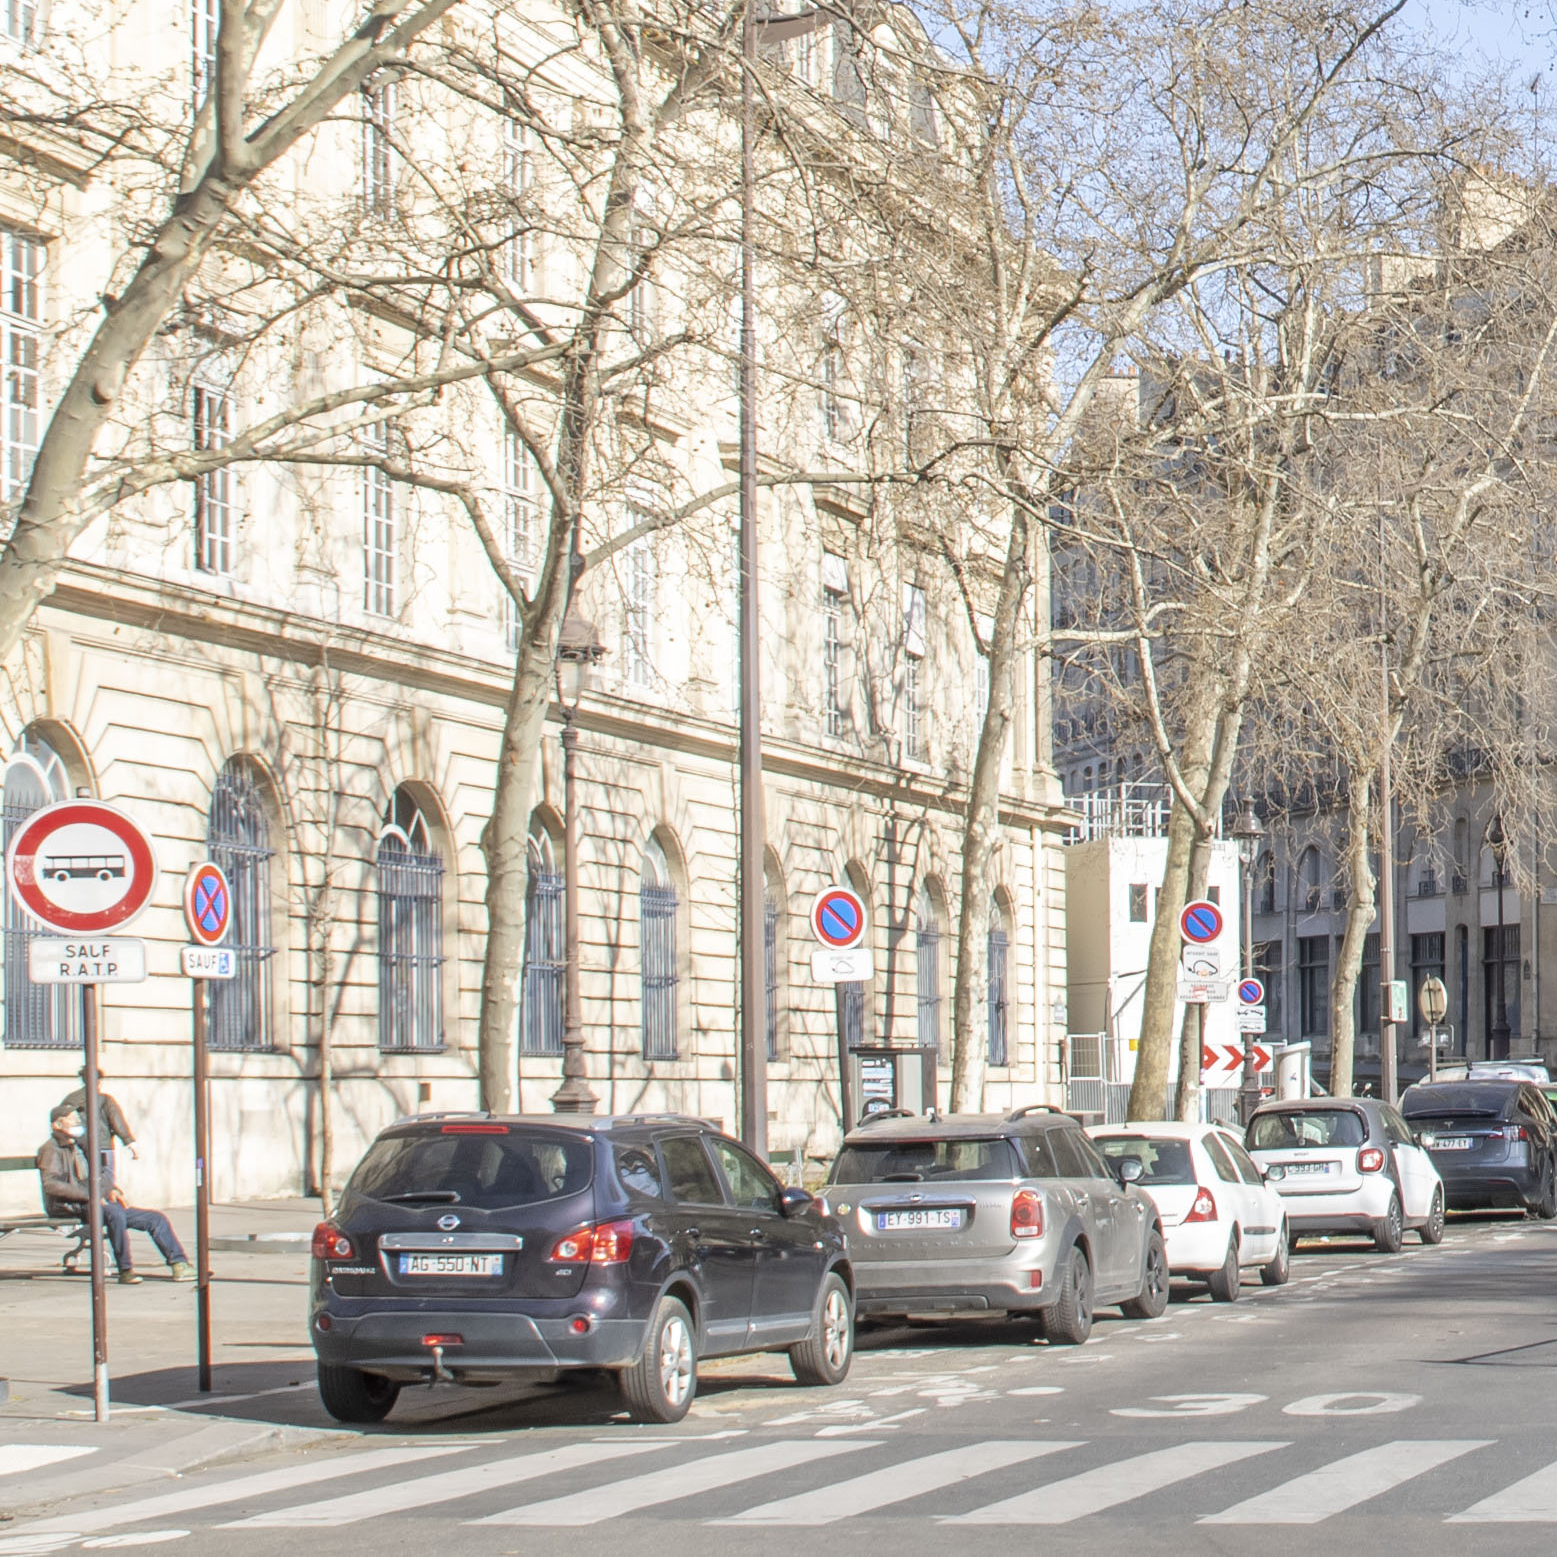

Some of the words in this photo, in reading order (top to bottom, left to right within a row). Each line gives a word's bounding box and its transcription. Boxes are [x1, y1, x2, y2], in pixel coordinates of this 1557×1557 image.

[65, 944, 111, 958] SAUF
[188, 953, 216, 969] SAUF
[887, 1211, 951, 1226] EY-991-TS
[410, 1255, 489, 1273] AG-550-NT
[1108, 1392, 1424, 1418] 30
